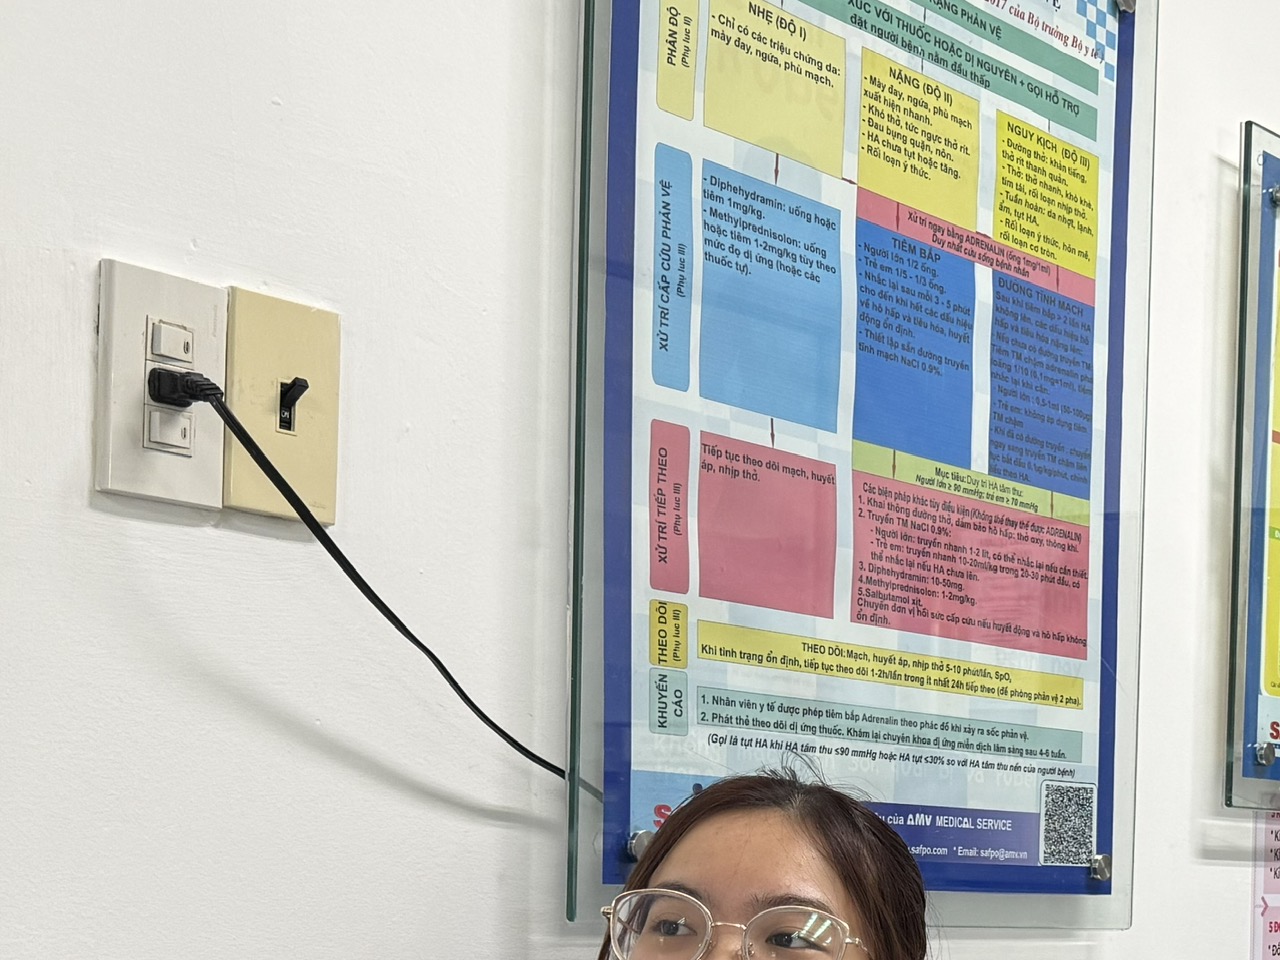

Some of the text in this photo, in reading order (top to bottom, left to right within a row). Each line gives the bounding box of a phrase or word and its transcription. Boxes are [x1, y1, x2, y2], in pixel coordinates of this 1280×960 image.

[666, 6, 681, 66] PHÂN ĐỘ
[749, 4, 807, 42] NHẸ (ĐỘ I)
[961, 9, 1002, 40] PHẢN VỆ
[711, 28, 834, 88] mày đay, ngứa, phù mạch.
[718, 13, 841, 76] Chỉ có các triệu chứng da:
[875, 6, 893, 24] VỚI
[896, 15, 931, 43] THUỐC
[934, 36, 963, 58] HOẶC
[965, 50, 975, 67] DỊ
[977, 57, 1017, 85] NGUYÊN
[1027, 80, 1043, 100] GỌI
[1062, 97, 1080, 116] TRỢ
[889, 66, 920, 90] NẶNG
[923, 81, 941, 101] (ĐỘ
[1007, 121, 1035, 141] NGUY
[1037, 131, 1057, 152] KỊCH
[1062, 145, 1078, 164] (ĐỘ
[703, 189, 765, 220] tiêm 1mg/kg.
[710, 175, 836, 231] Diphehydramin: uống hoặc
[704, 220, 836, 274] hoặc tiêm 1-2mg/kg tùy theo
[710, 206, 827, 259] Methylprednisolon: uống
[892, 237, 941, 263] TIÊM BẮP
[656, 179, 673, 351] XỬ TRÍ CẤP CỨU PHẢN VỆ
[701, 443, 835, 485] Tiếp tục theo dõi mạch, huyết
[701, 462, 760, 482] áp, nhịp thở.
[653, 447, 668, 563] XỬ TRÍ TIẾP THEO
[657, 601, 668, 664] THEO DÕI
[654, 673, 668, 729] KHUYẾN
[670, 689, 683, 718] CÁO
[712, 695, 898, 726] Nhân viên y tế được phép tiêm bắp Adrenalin
[887, 814, 904, 825] của
[936, 816, 974, 829] MEDICAL
[977, 818, 1012, 831] SERVICE
[958, 846, 978, 857] Email:
[1269, 922, 1273, 933] 5
